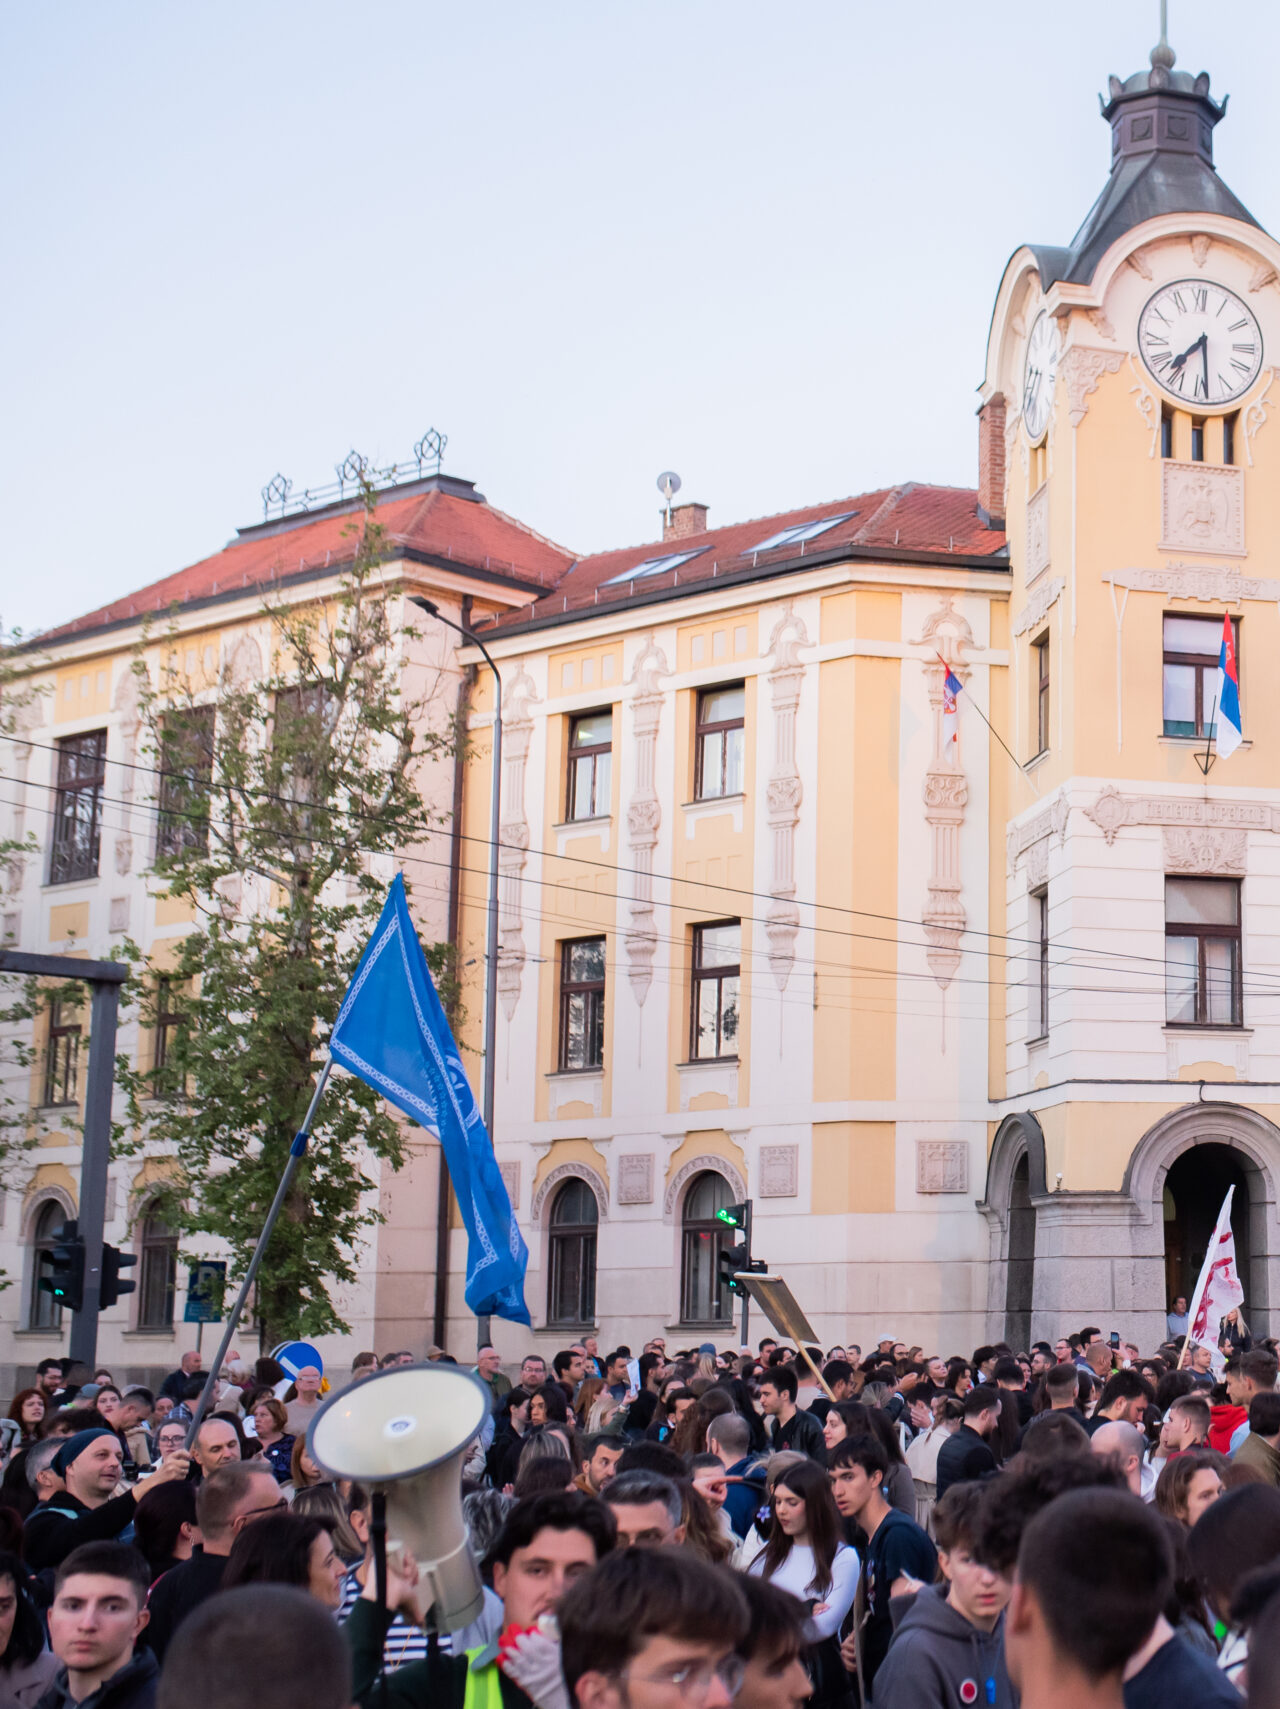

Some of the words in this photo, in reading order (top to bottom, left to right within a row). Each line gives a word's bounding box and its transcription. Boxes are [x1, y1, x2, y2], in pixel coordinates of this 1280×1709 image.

[1191, 288, 1208, 313] XII
[1215, 298, 1228, 318] I
[1148, 307, 1174, 328] X
[1227, 318, 1249, 332] II
[1232, 343, 1255, 354] III
